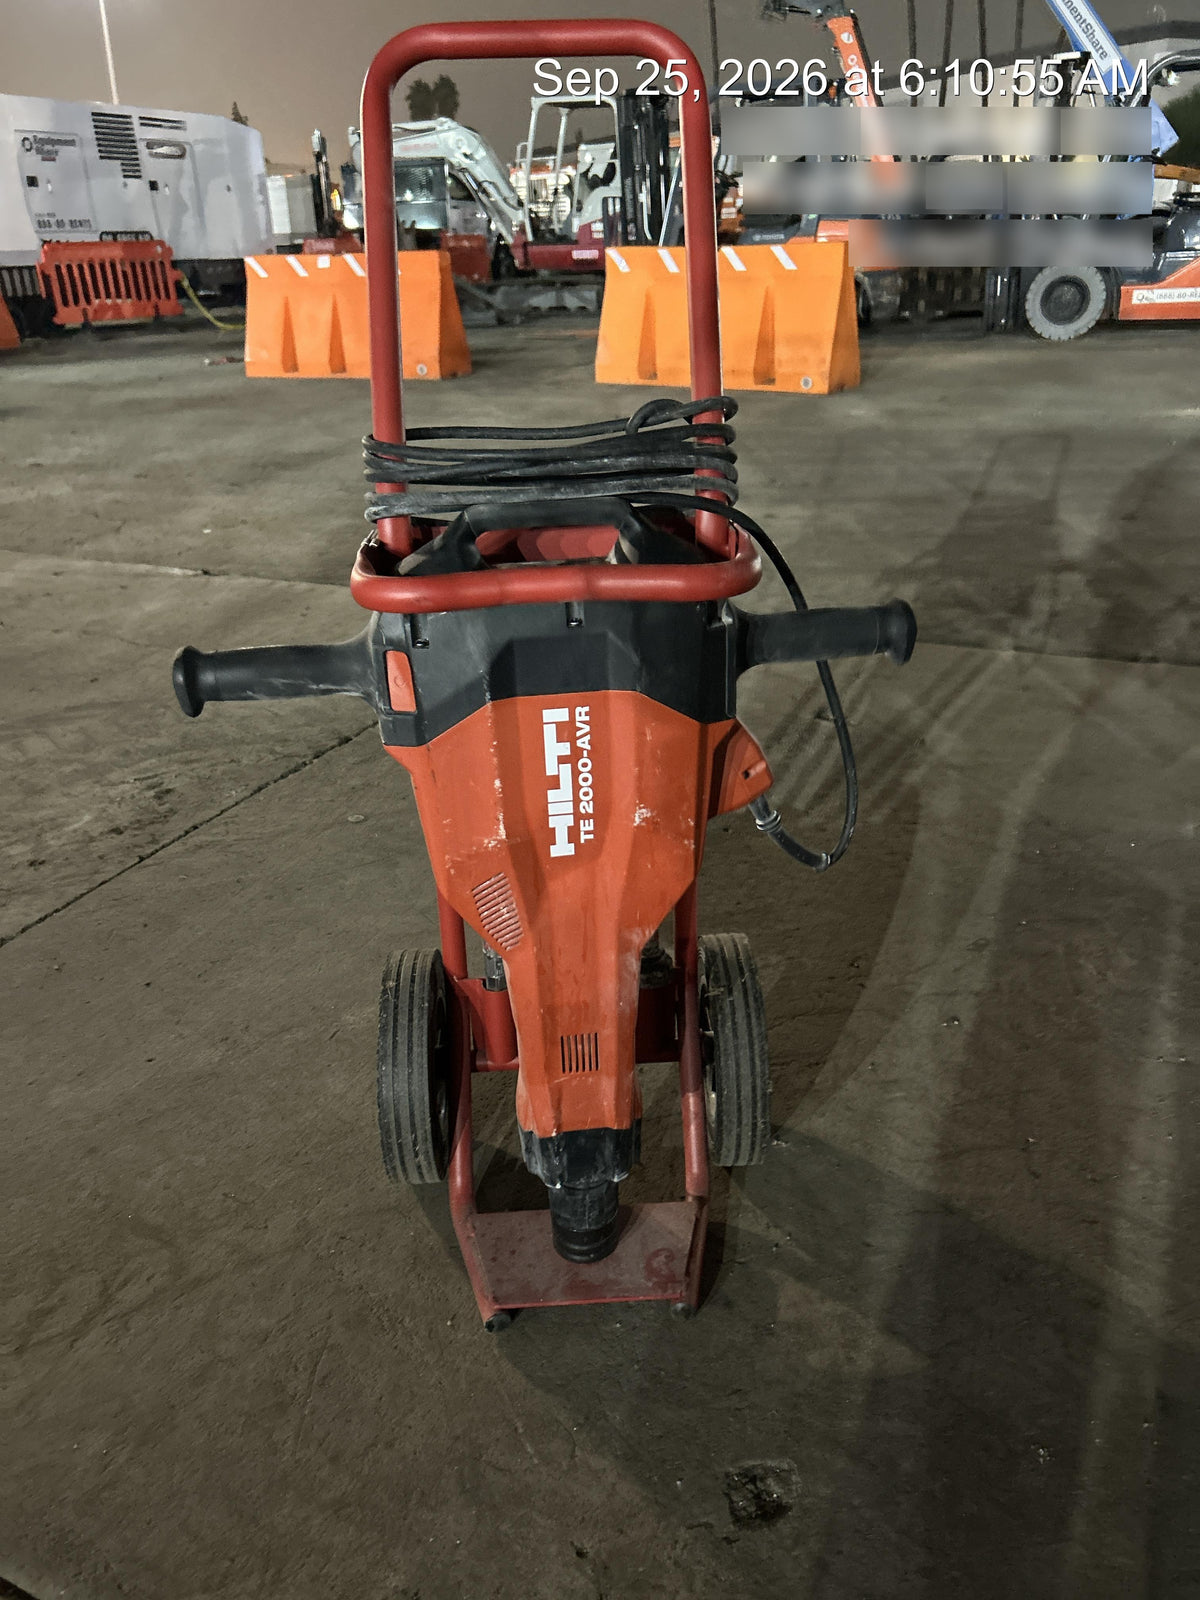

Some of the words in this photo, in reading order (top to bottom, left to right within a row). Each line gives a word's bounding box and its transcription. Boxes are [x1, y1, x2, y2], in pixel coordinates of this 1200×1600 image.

[542, 707, 576, 858] HILTI
[575, 705, 594, 814] 2000-AVR
[580, 818, 595, 844] TE
